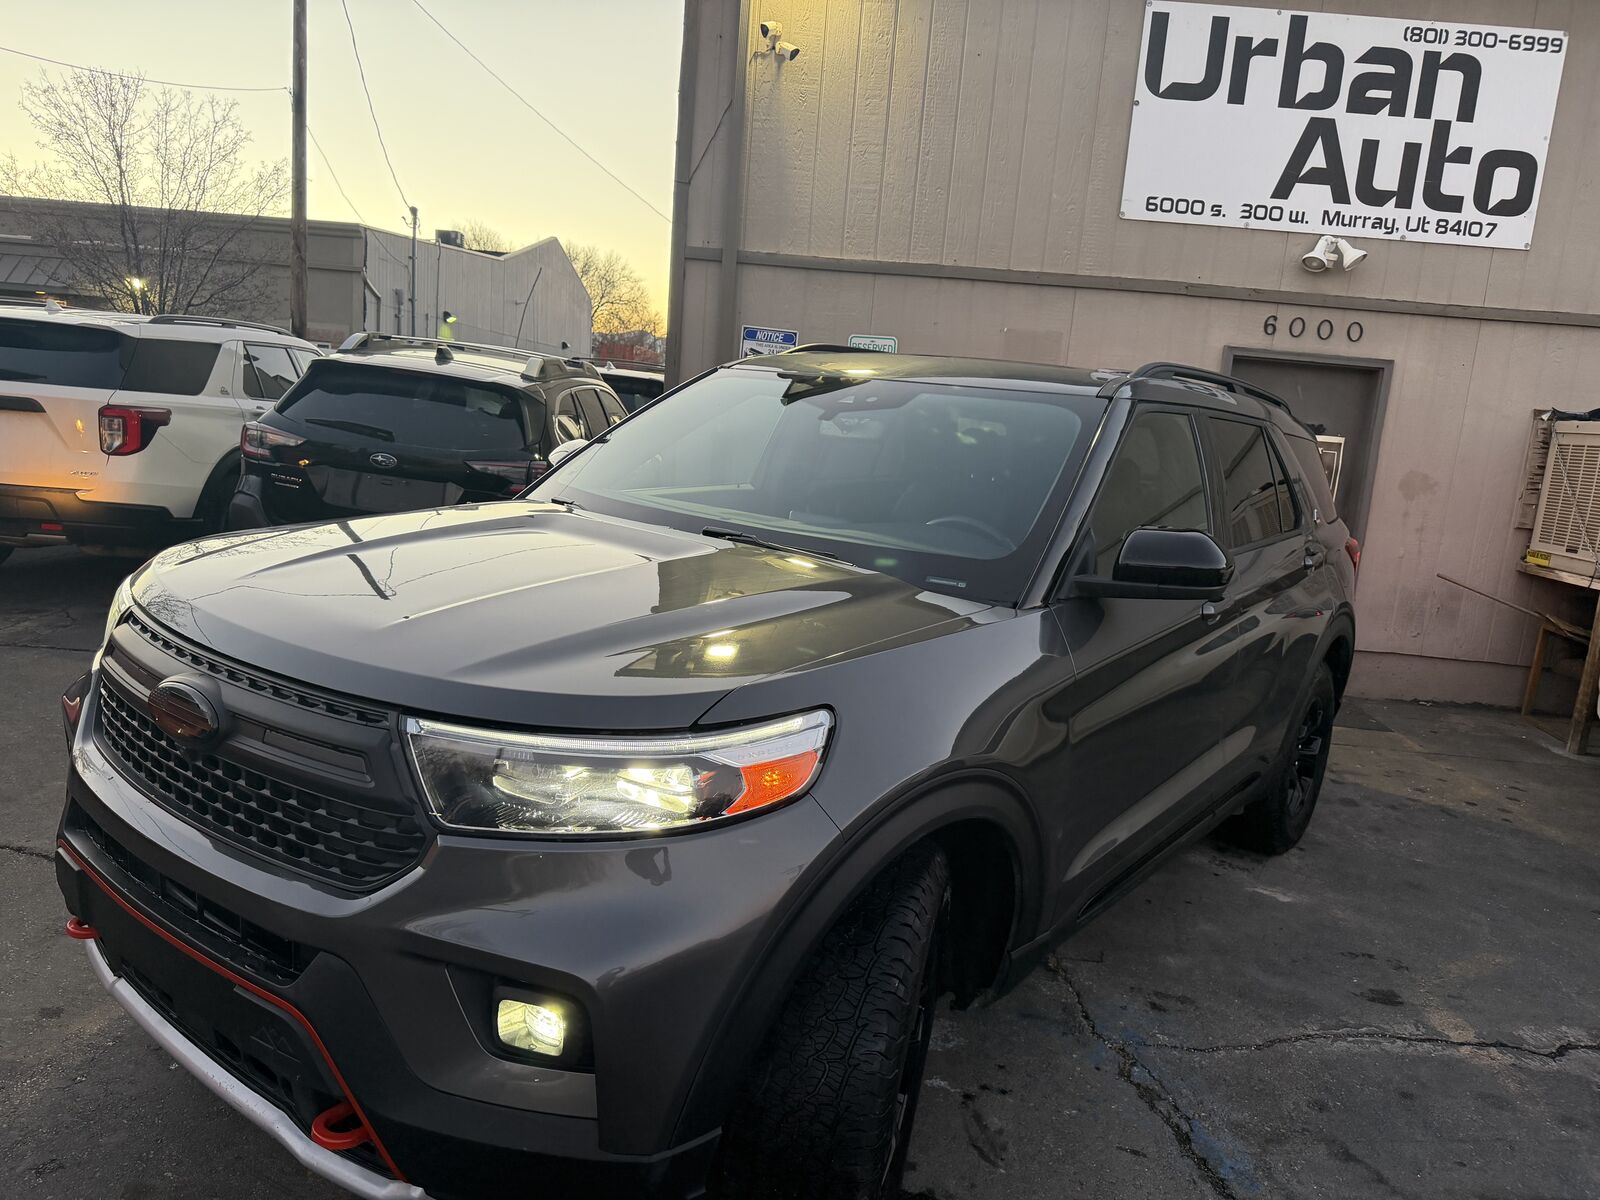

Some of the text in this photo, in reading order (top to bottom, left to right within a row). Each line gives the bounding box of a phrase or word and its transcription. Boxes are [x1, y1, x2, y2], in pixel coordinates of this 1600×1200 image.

[1403, 26, 1564, 54] (801) 300-6999
[1145, 11, 1482, 123] Urban
[1269, 117, 1538, 218] Auto
[1145, 196, 1206, 216] 6000
[1210, 204, 1226, 218] s.
[1239, 203, 1284, 222] 300
[1321, 209, 1400, 235] Murray,
[1405, 215, 1431, 234] Ut
[1434, 218, 1498, 239] 84107
[755, 330, 785, 342] NOTICE
[1263, 314, 1365, 343] 6000
[852, 342, 894, 353] RESERVED
